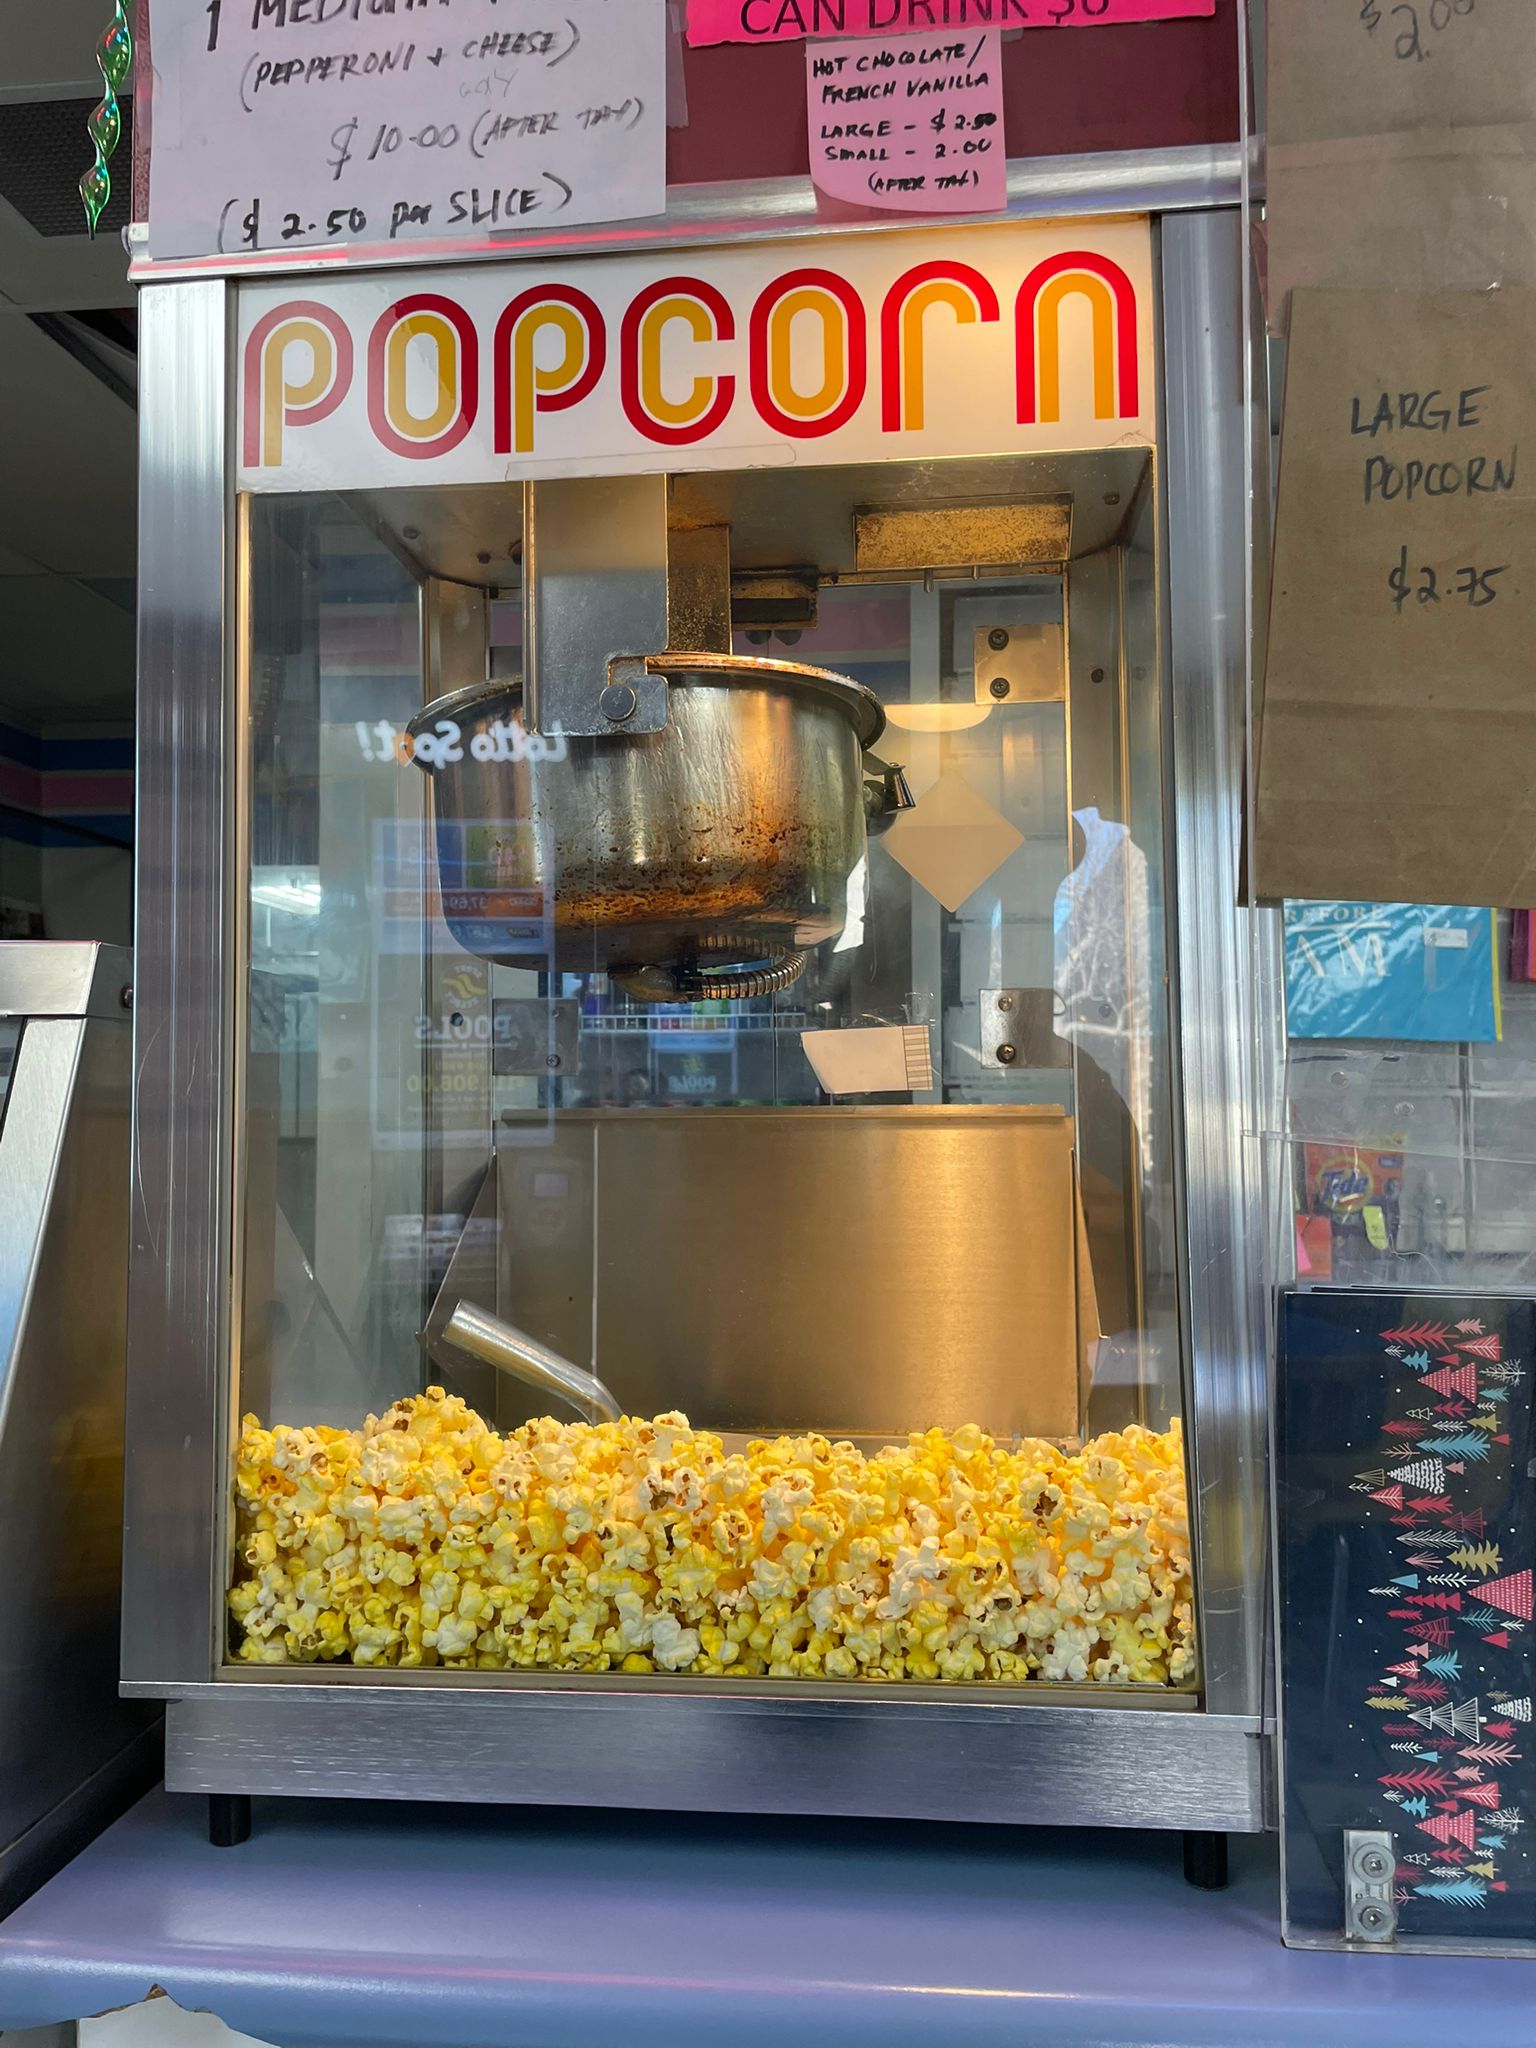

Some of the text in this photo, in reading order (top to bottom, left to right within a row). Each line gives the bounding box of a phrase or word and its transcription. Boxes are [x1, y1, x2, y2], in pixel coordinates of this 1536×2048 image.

[206, 0, 450, 51] 1 MEDI
[740, 0, 845, 35] CAN
[868, 0, 1029, 30] DRINK
[813, 57, 848, 79] HOT
[822, 72, 989, 105] FRENCH VANILLA
[821, 120, 893, 140] LARGE
[824, 145, 890, 161] SMALL
[447, 172, 573, 225] SLICE)
[867, 170, 926, 196] (AFTER
[1350, 385, 1493, 437] LARGE
[1362, 445, 1518, 505] POPCORN
[1387, 545, 1508, 614] $2.75
